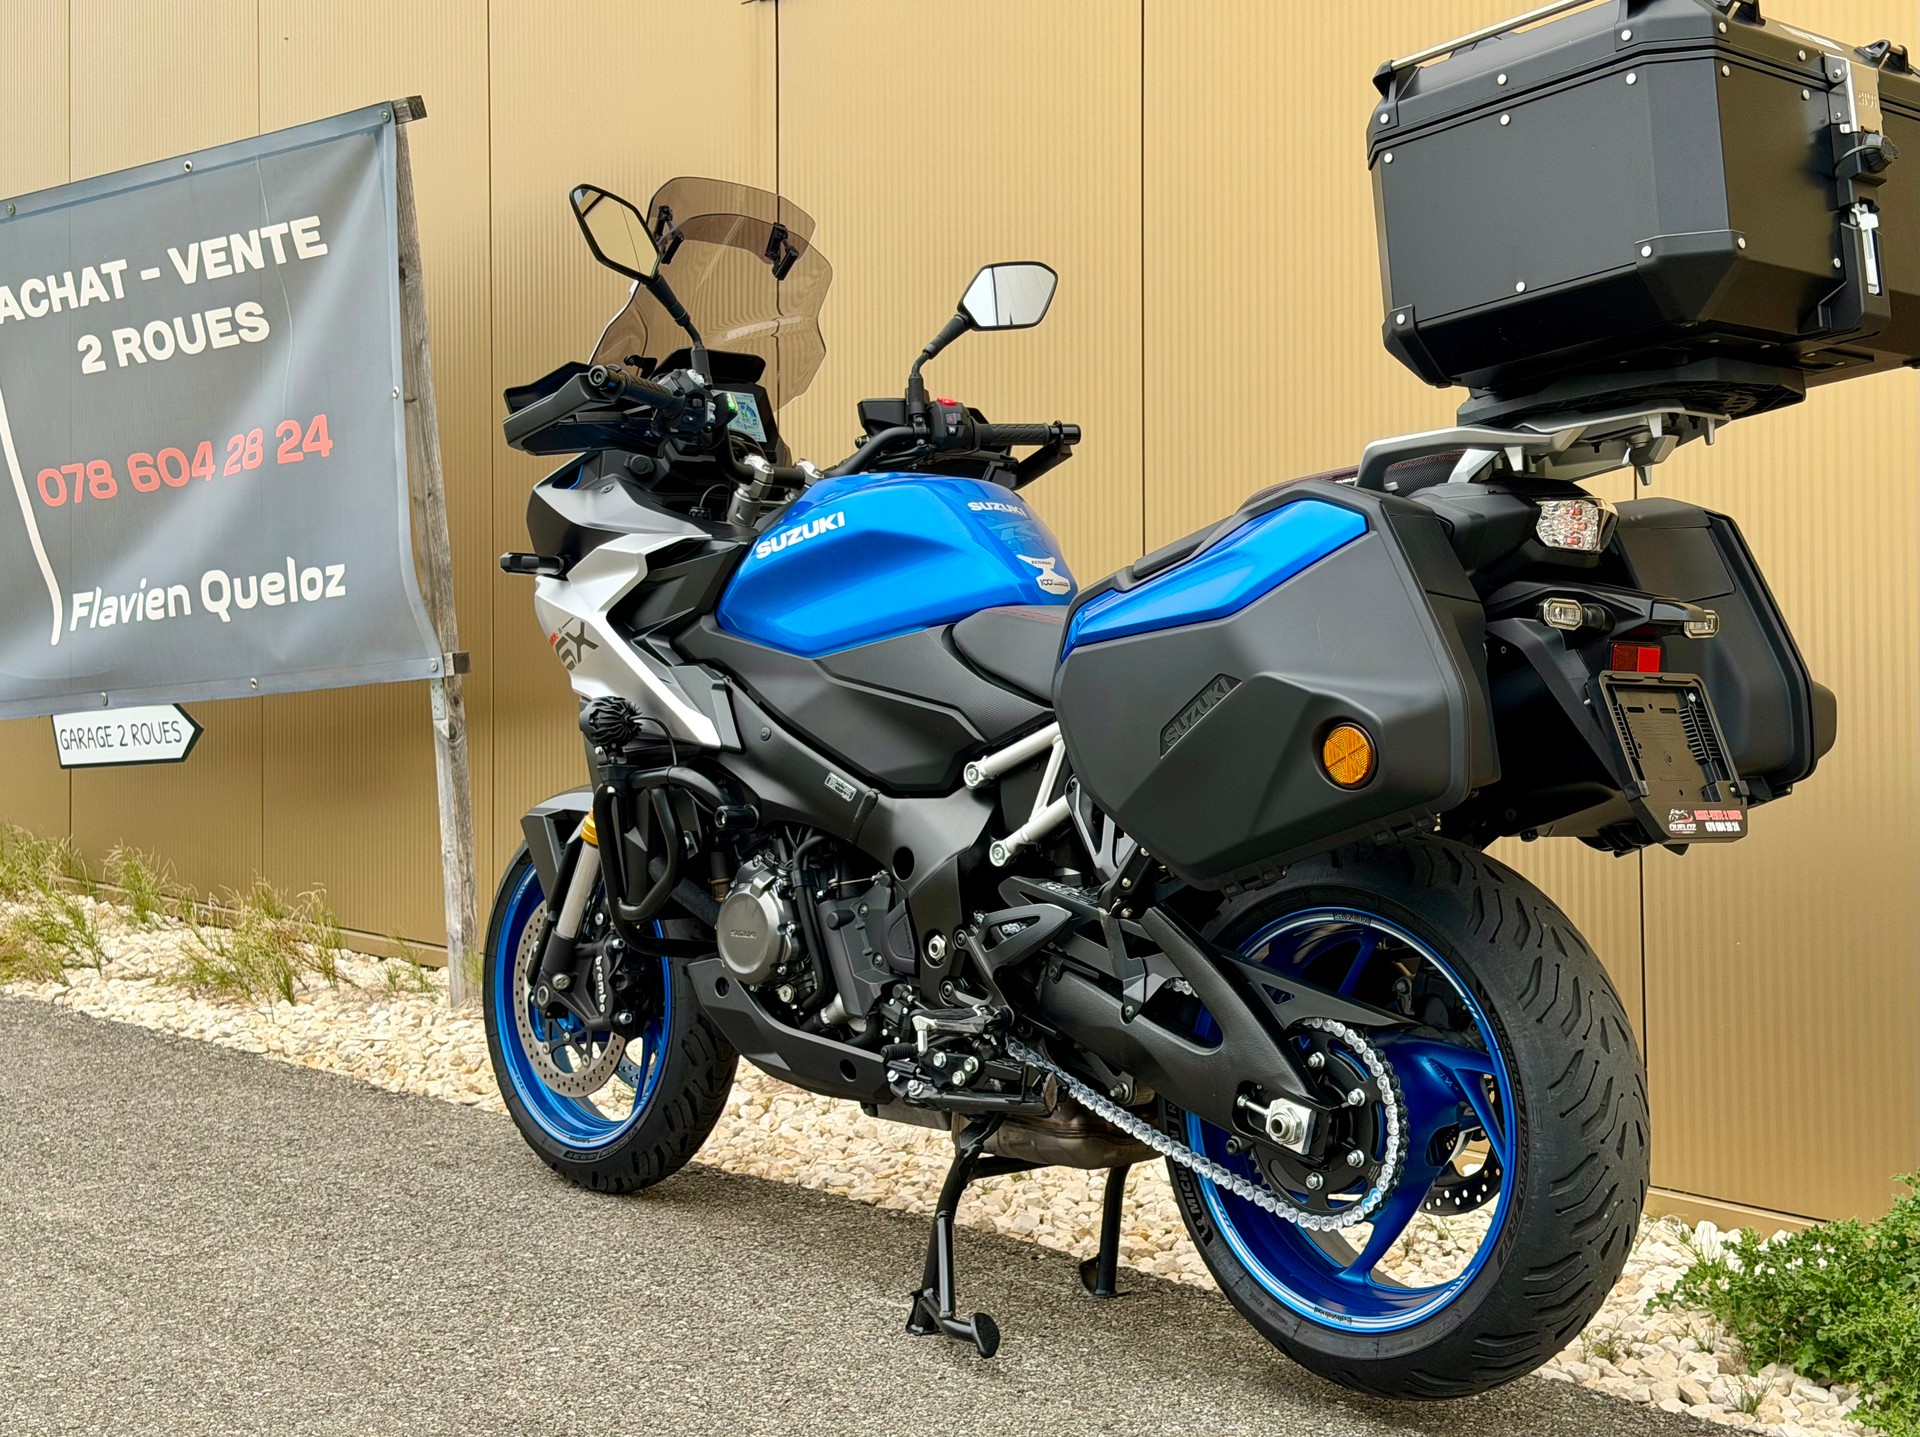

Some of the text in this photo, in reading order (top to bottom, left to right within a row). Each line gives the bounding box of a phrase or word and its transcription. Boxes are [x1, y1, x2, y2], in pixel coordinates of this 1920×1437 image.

[0, 259, 127, 325] ACHAT
[167, 216, 328, 285] VENTE
[77, 302, 270, 375] 2 ROUES
[37, 414, 333, 507] 078 604 28 24
[756, 511, 846, 559] SUZUKI
[967, 502, 1029, 518] SUZUKI
[70, 556, 346, 631] Flavien Queloz
[60, 720, 183, 750] GARAGE 2 ROUES
[1164, 677, 1231, 746] SUZUKI
[595, 955, 607, 1013] brembo
